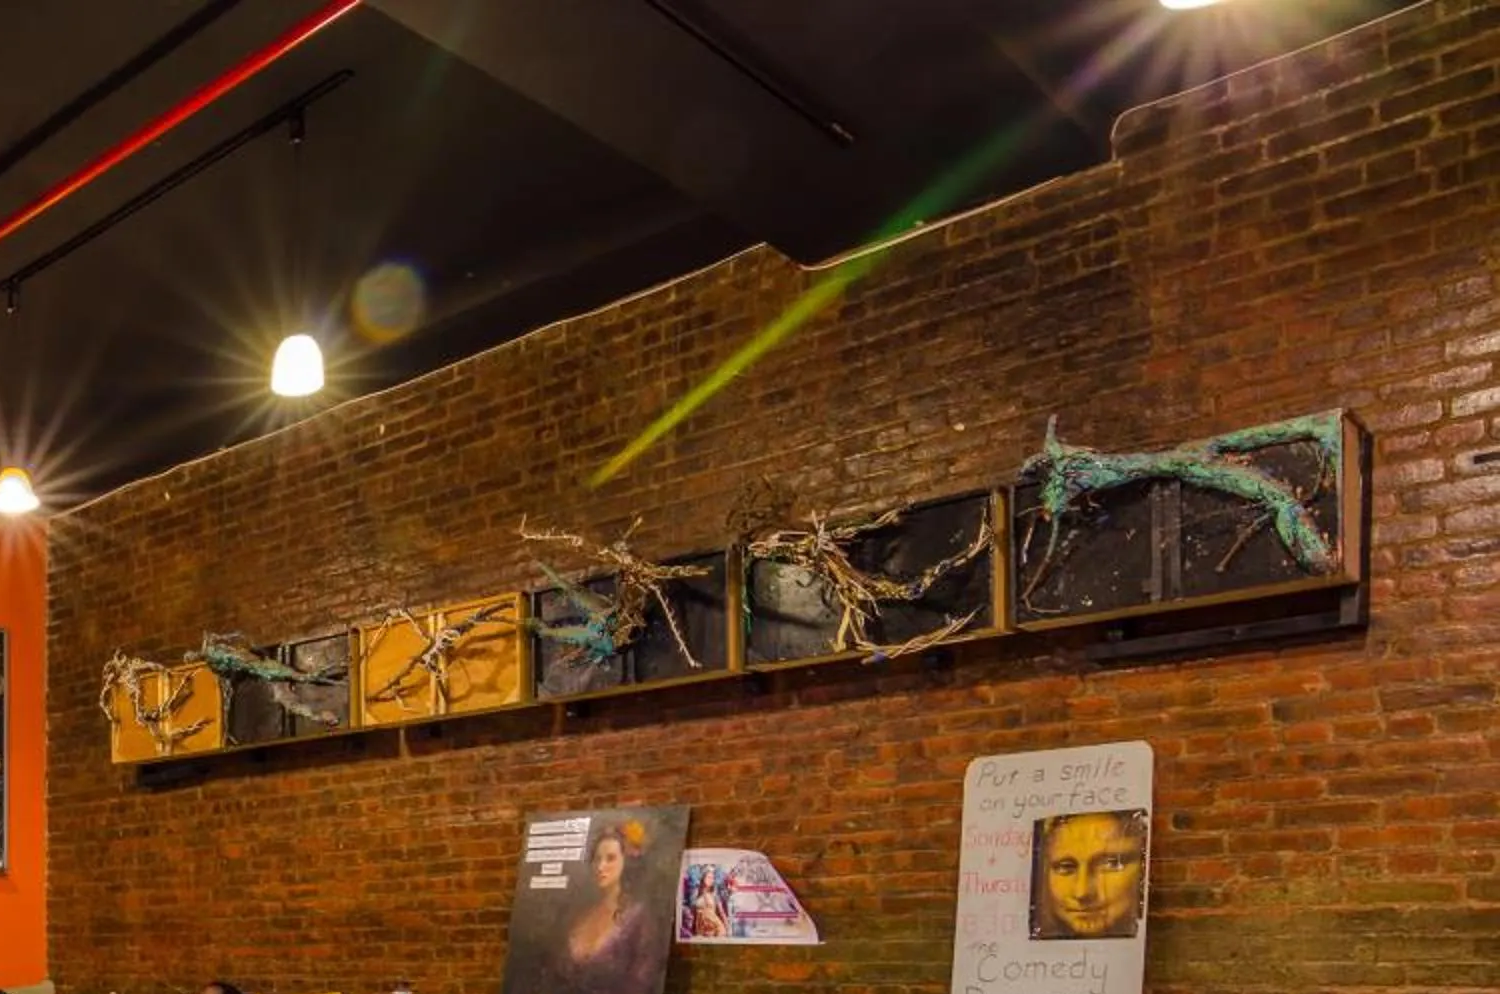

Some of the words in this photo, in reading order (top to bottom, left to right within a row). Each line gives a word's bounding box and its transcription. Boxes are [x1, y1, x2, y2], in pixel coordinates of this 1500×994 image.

[976, 760, 1020, 788] Put
[1032, 766, 1045, 784] a
[1059, 752, 1126, 783] smile
[978, 795, 1005, 813] on
[1013, 792, 1062, 819] your
[1067, 784, 1129, 808] face
